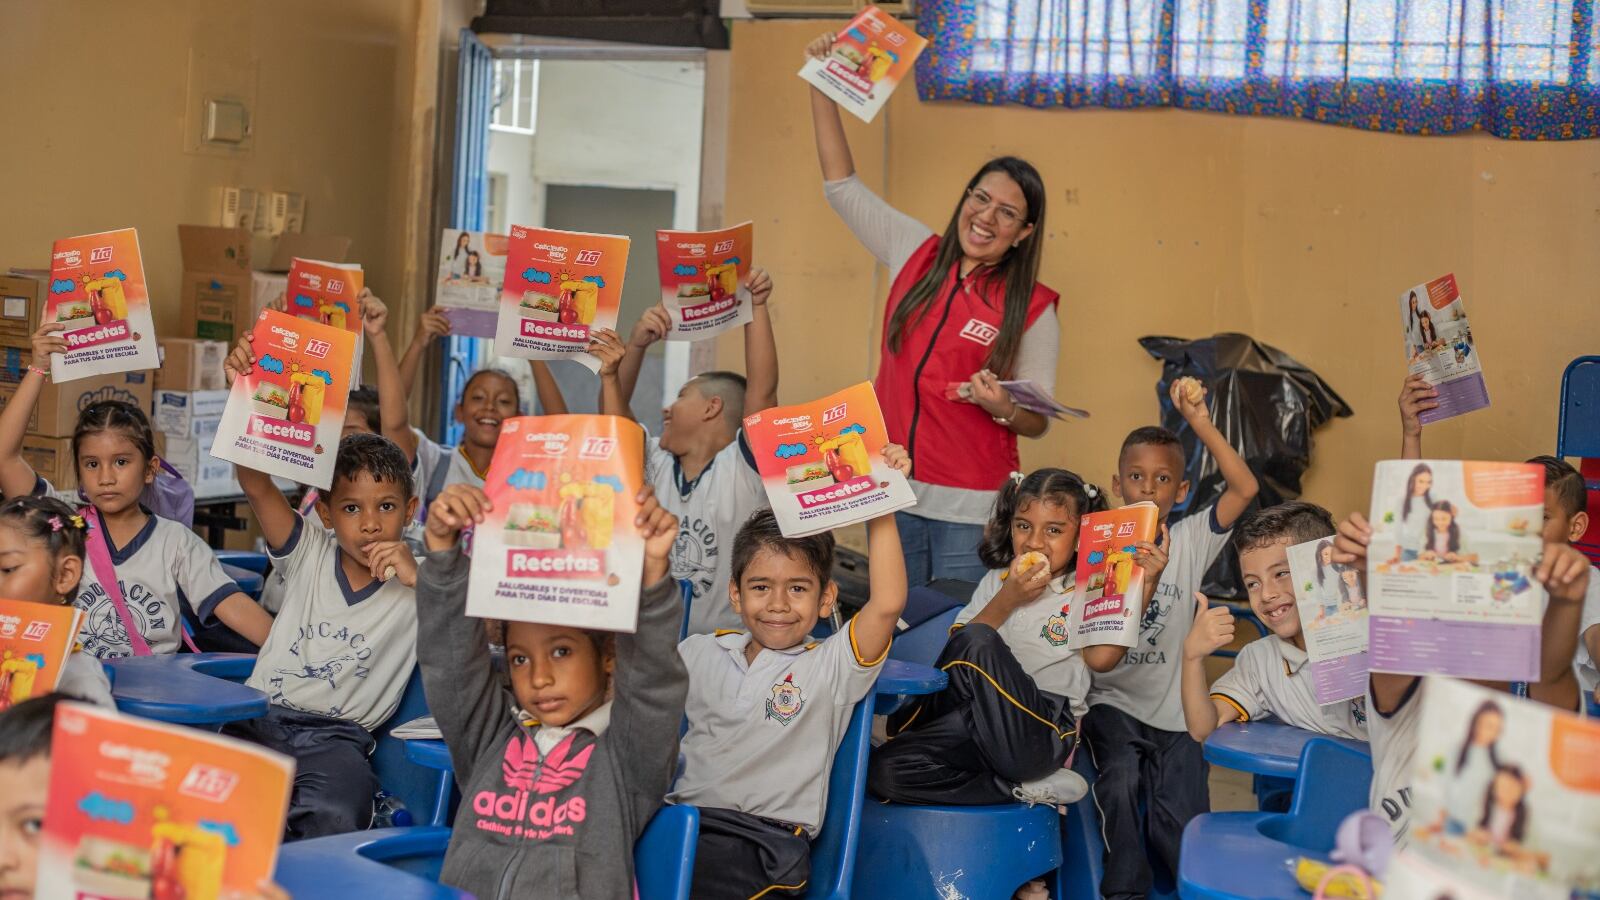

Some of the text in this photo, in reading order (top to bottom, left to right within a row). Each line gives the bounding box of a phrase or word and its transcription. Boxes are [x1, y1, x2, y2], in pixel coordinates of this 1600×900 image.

[685, 298, 733, 318] Recetas
[68, 326, 126, 346] Recetas
[525, 322, 585, 338] Recetas
[514, 338, 551, 347] SALUDABLES
[64, 350, 98, 359] SALUDABLES
[105, 345, 136, 353] DIVERTIDAS
[115, 350, 138, 358] ESCUELA
[252, 418, 311, 441] Recetas
[802, 481, 871, 505] Recetas
[861, 494, 890, 506] ESCUELA
[799, 503, 841, 515] SALUDABLES
[848, 491, 885, 505] DIVERTIDAS
[512, 553, 599, 572] Recetas
[498, 581, 550, 593] SALUDABLES
[559, 587, 608, 598] DIVERTIDAS
[495, 590, 517, 598] PARA
[520, 592, 535, 600] TUS
[572, 597, 608, 607] ESCUELA
[1124, 650, 1166, 665] ISICA
[473, 790, 586, 827] adidas
